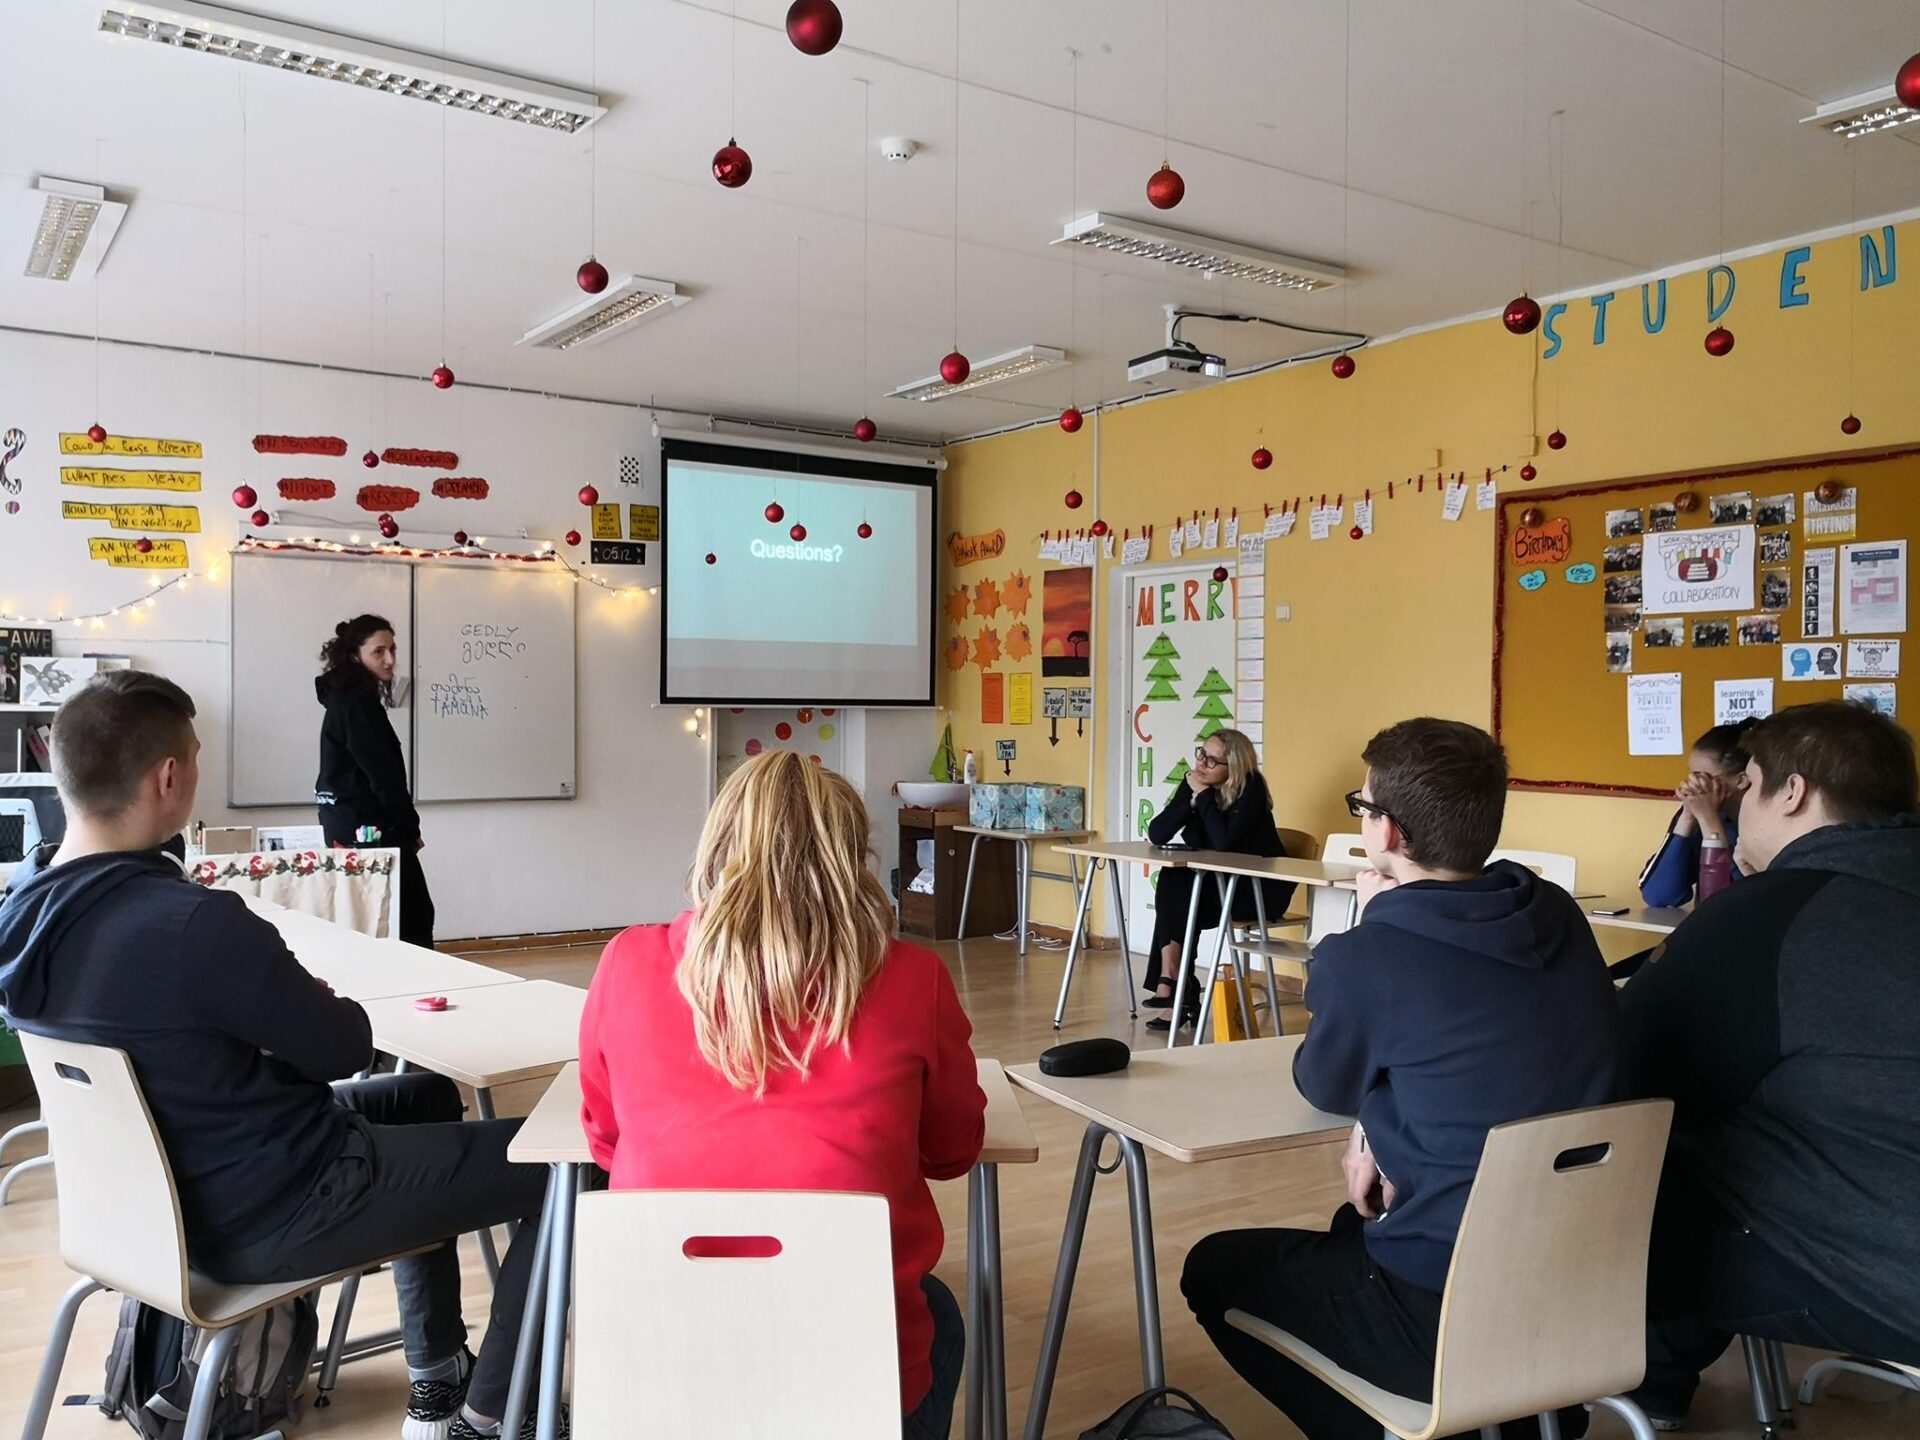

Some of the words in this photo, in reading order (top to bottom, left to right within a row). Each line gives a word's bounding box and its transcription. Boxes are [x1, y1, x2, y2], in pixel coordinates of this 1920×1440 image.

[65, 469, 98, 483] WHAT
[65, 504, 87, 515] HOW
[89, 504, 107, 515] DO
[91, 542, 115, 553] CAN
[750, 538, 844, 563] Questions?
[1662, 586, 1740, 604] COLLABORATION
[461, 624, 519, 639] GEDLY
[1721, 689, 1754, 700] learning
[1756, 689, 1764, 697] is
[1729, 697, 1756, 709] NOT
[1726, 708, 1767, 719] Spectator
